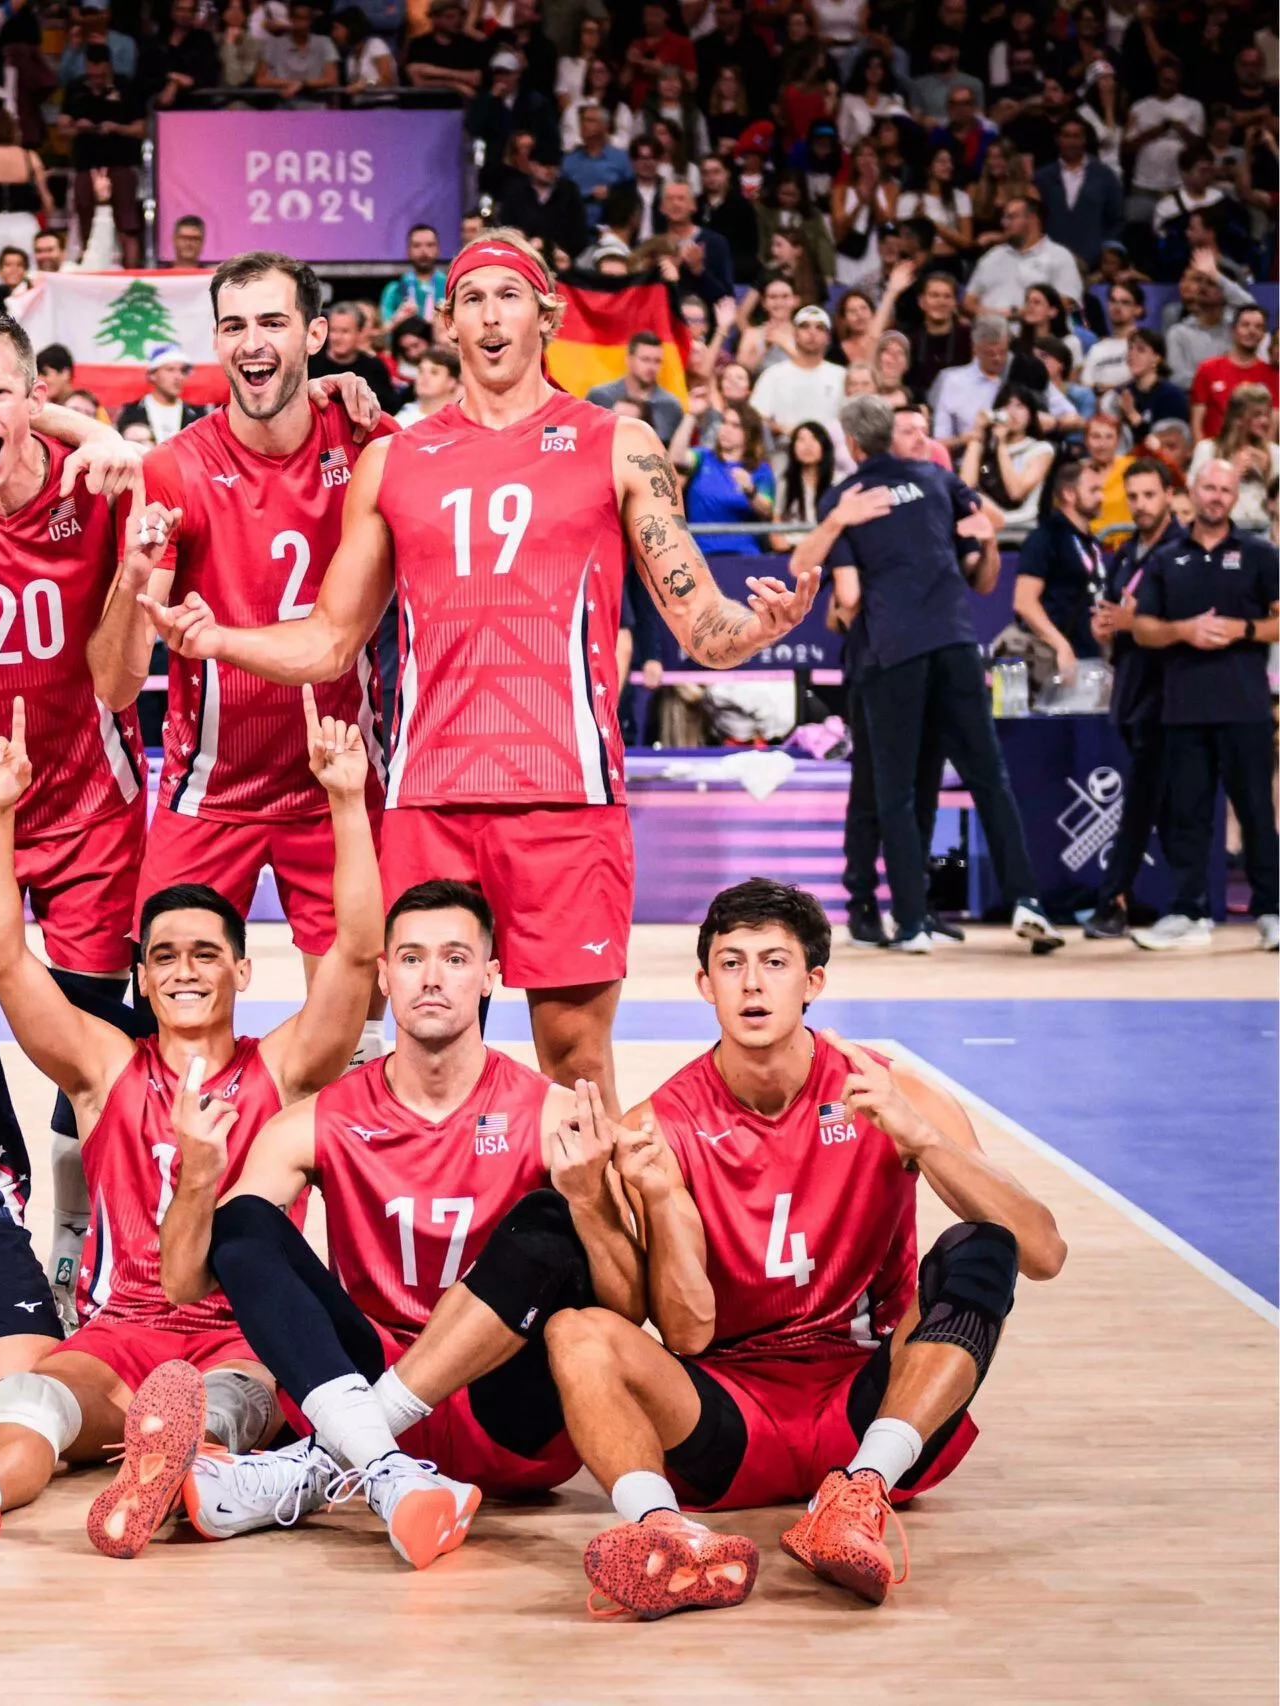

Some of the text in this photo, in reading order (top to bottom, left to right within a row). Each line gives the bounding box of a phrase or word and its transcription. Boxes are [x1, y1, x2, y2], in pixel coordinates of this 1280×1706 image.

[246, 150, 375, 184] PARIS
[247, 189, 374, 223] 2024
[540, 438, 576, 452] USA
[322, 467, 352, 488] USA
[48, 518, 82, 542] USA
[440, 483, 533, 577] 19
[271, 529, 316, 622] 2
[475, 1134, 509, 1155] USA
[820, 1123, 857, 1145] USA
[385, 1196, 474, 1288] 17
[765, 1193, 815, 1287] 4
